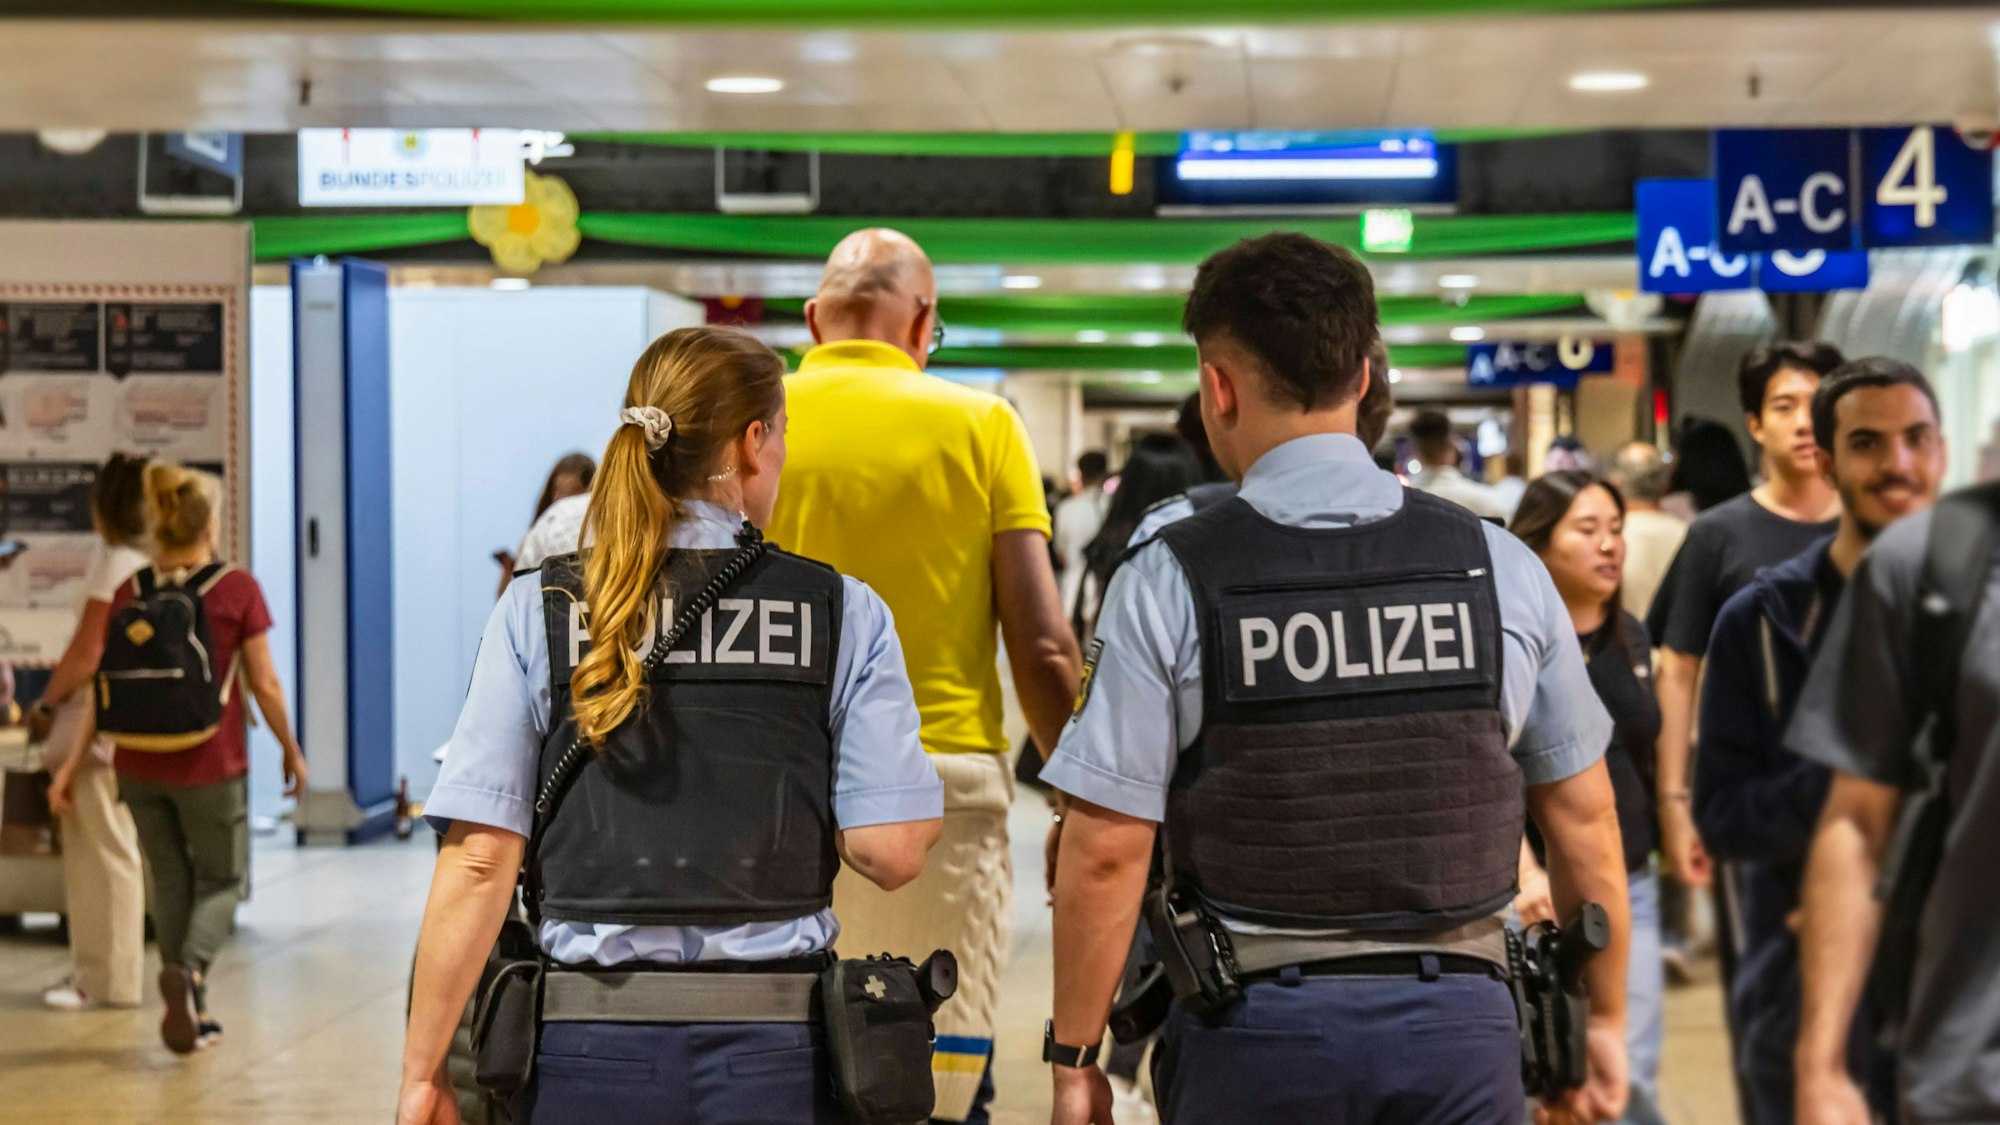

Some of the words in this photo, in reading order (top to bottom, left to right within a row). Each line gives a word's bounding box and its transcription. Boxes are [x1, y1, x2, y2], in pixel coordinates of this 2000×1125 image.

[1727, 173, 1846, 234] A-C
[1876, 125, 1947, 227] 4
[1239, 602, 1476, 686] POLIZEI
